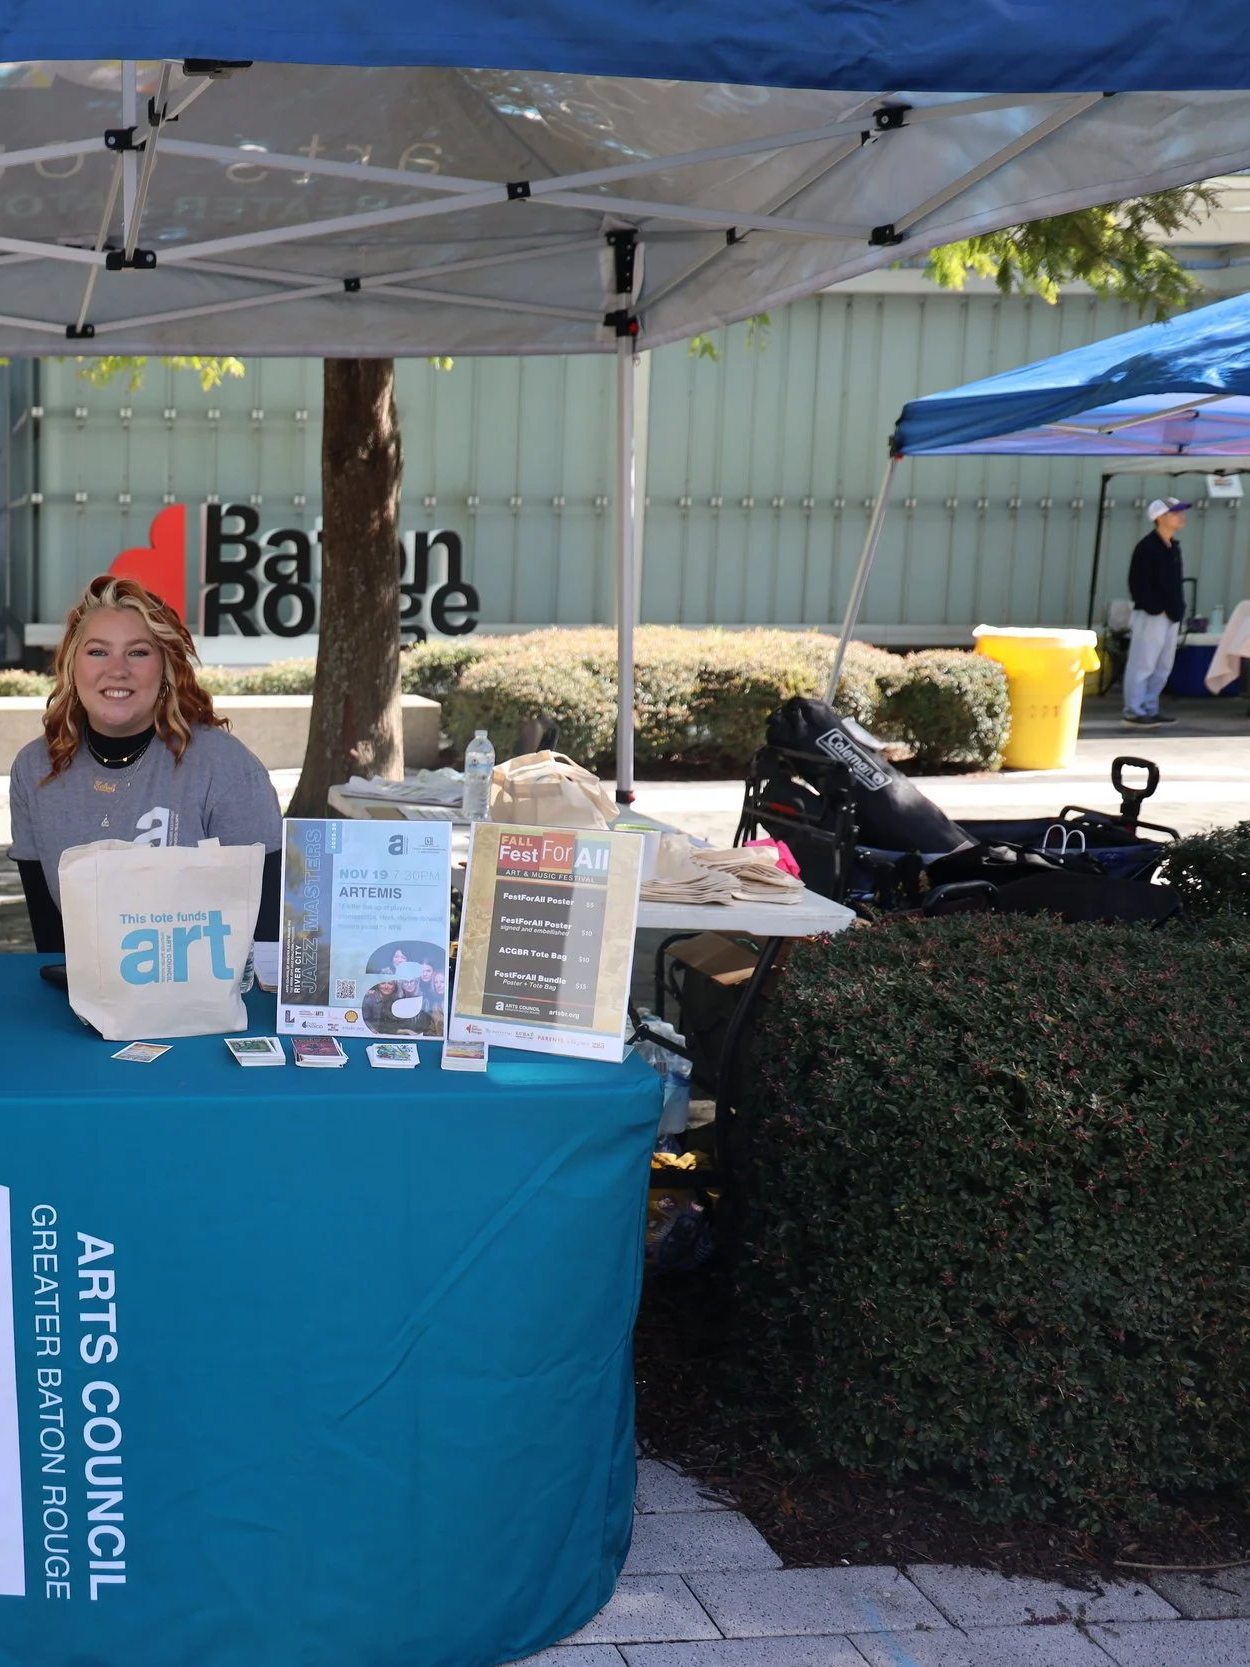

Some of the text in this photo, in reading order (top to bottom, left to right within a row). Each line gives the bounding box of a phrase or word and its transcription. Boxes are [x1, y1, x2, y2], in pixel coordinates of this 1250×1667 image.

[202, 503, 461, 590] Ban
[828, 732, 874, 776] Coleman
[502, 835, 533, 846] FALL
[500, 840, 609, 870] Fest For All
[304, 828, 322, 931] MASTERS
[340, 869, 369, 879] NOV
[372, 870, 388, 880] 19
[559, 873, 594, 883] FESTIVAL
[339, 887, 402, 899] ARTEMIS
[503, 892, 546, 903] FestForAll
[547, 897, 574, 906] Poster
[120, 911, 207, 924] This tote funds
[500, 916, 572, 930] FestForAll Poster
[120, 910, 234, 985] art
[499, 947, 529, 956] ACGBR
[531, 950, 549, 958] Tote
[551, 952, 567, 962] Bag
[302, 938, 318, 994] JAZZ
[494, 970, 566, 985] FestForAll Bundle
[549, 1010, 580, 1020] artsbr.org
[31, 1204, 70, 1600] GREATER BATON ROUGE
[77, 1230, 126, 1602] ARTS COUNCIL
